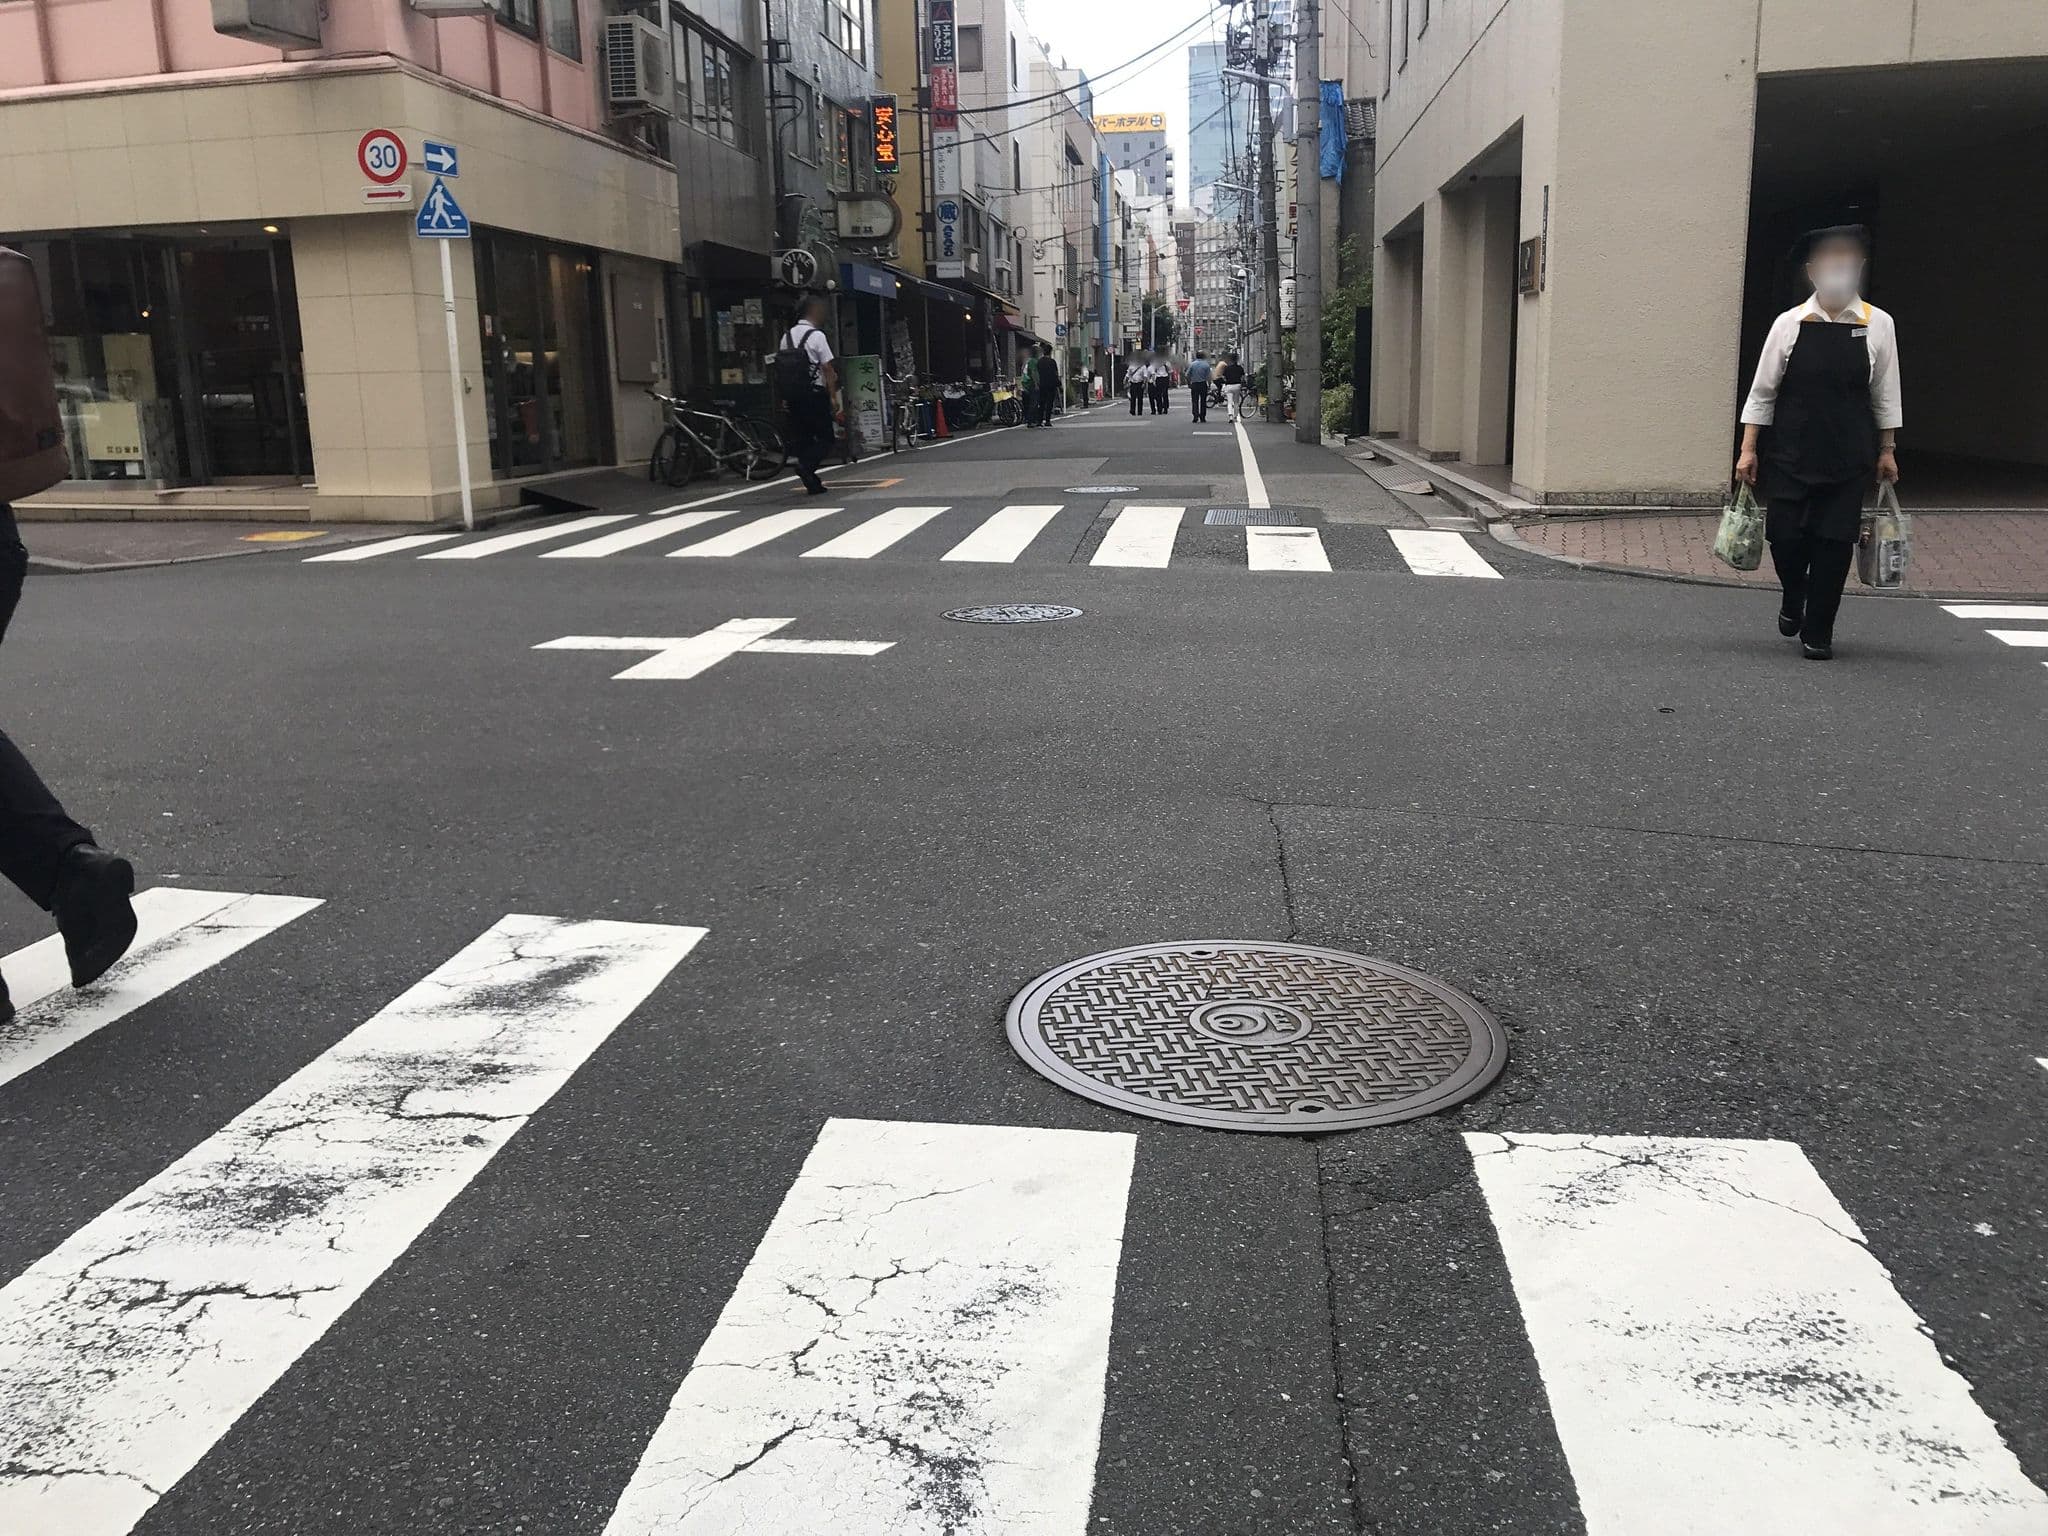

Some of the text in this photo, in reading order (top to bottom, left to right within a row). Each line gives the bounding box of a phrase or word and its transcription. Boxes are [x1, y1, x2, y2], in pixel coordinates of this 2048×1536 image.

[942, 24, 952, 55] エアガン
[369, 144, 397, 169] 30
[783, 252, 811, 268] WINE
[1285, 286, 1295, 321] おでん
[860, 361, 878, 412] 安心堂
